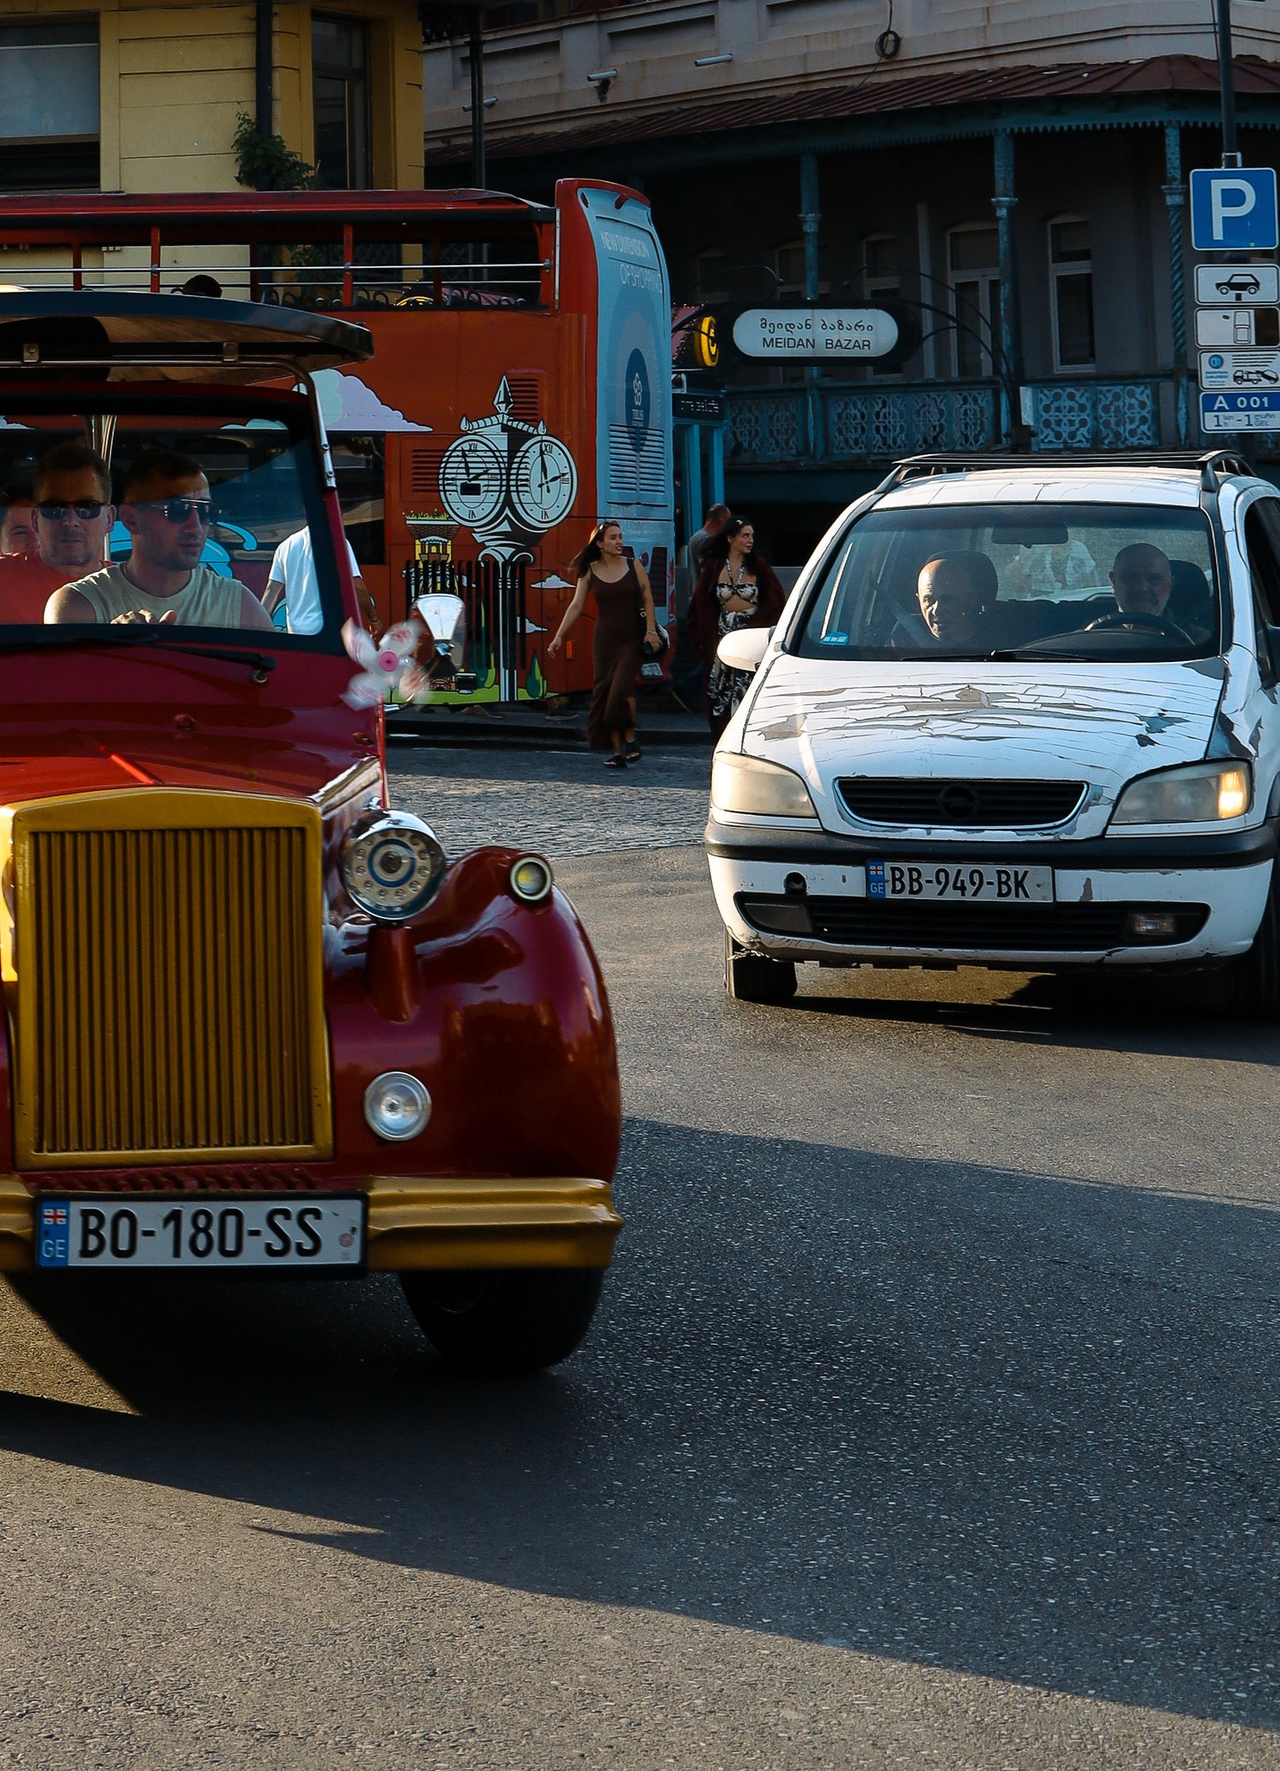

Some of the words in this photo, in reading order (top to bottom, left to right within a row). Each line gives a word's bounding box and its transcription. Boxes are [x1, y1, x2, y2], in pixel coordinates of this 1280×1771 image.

[1210, 179, 1256, 241] P
[760, 318, 812, 334] მეიდან
[821, 318, 874, 332] ბაზარი
[762, 337, 815, 349] MEIDAN
[825, 338, 871, 350] BAZAR
[1214, 395, 1229, 410] A
[1237, 397, 1268, 408] 001
[870, 882, 884, 894] GE
[890, 866, 1031, 899] BB-949-BK
[42, 1239, 66, 1259] GE
[79, 1206, 323, 1259] BO-180-SS
